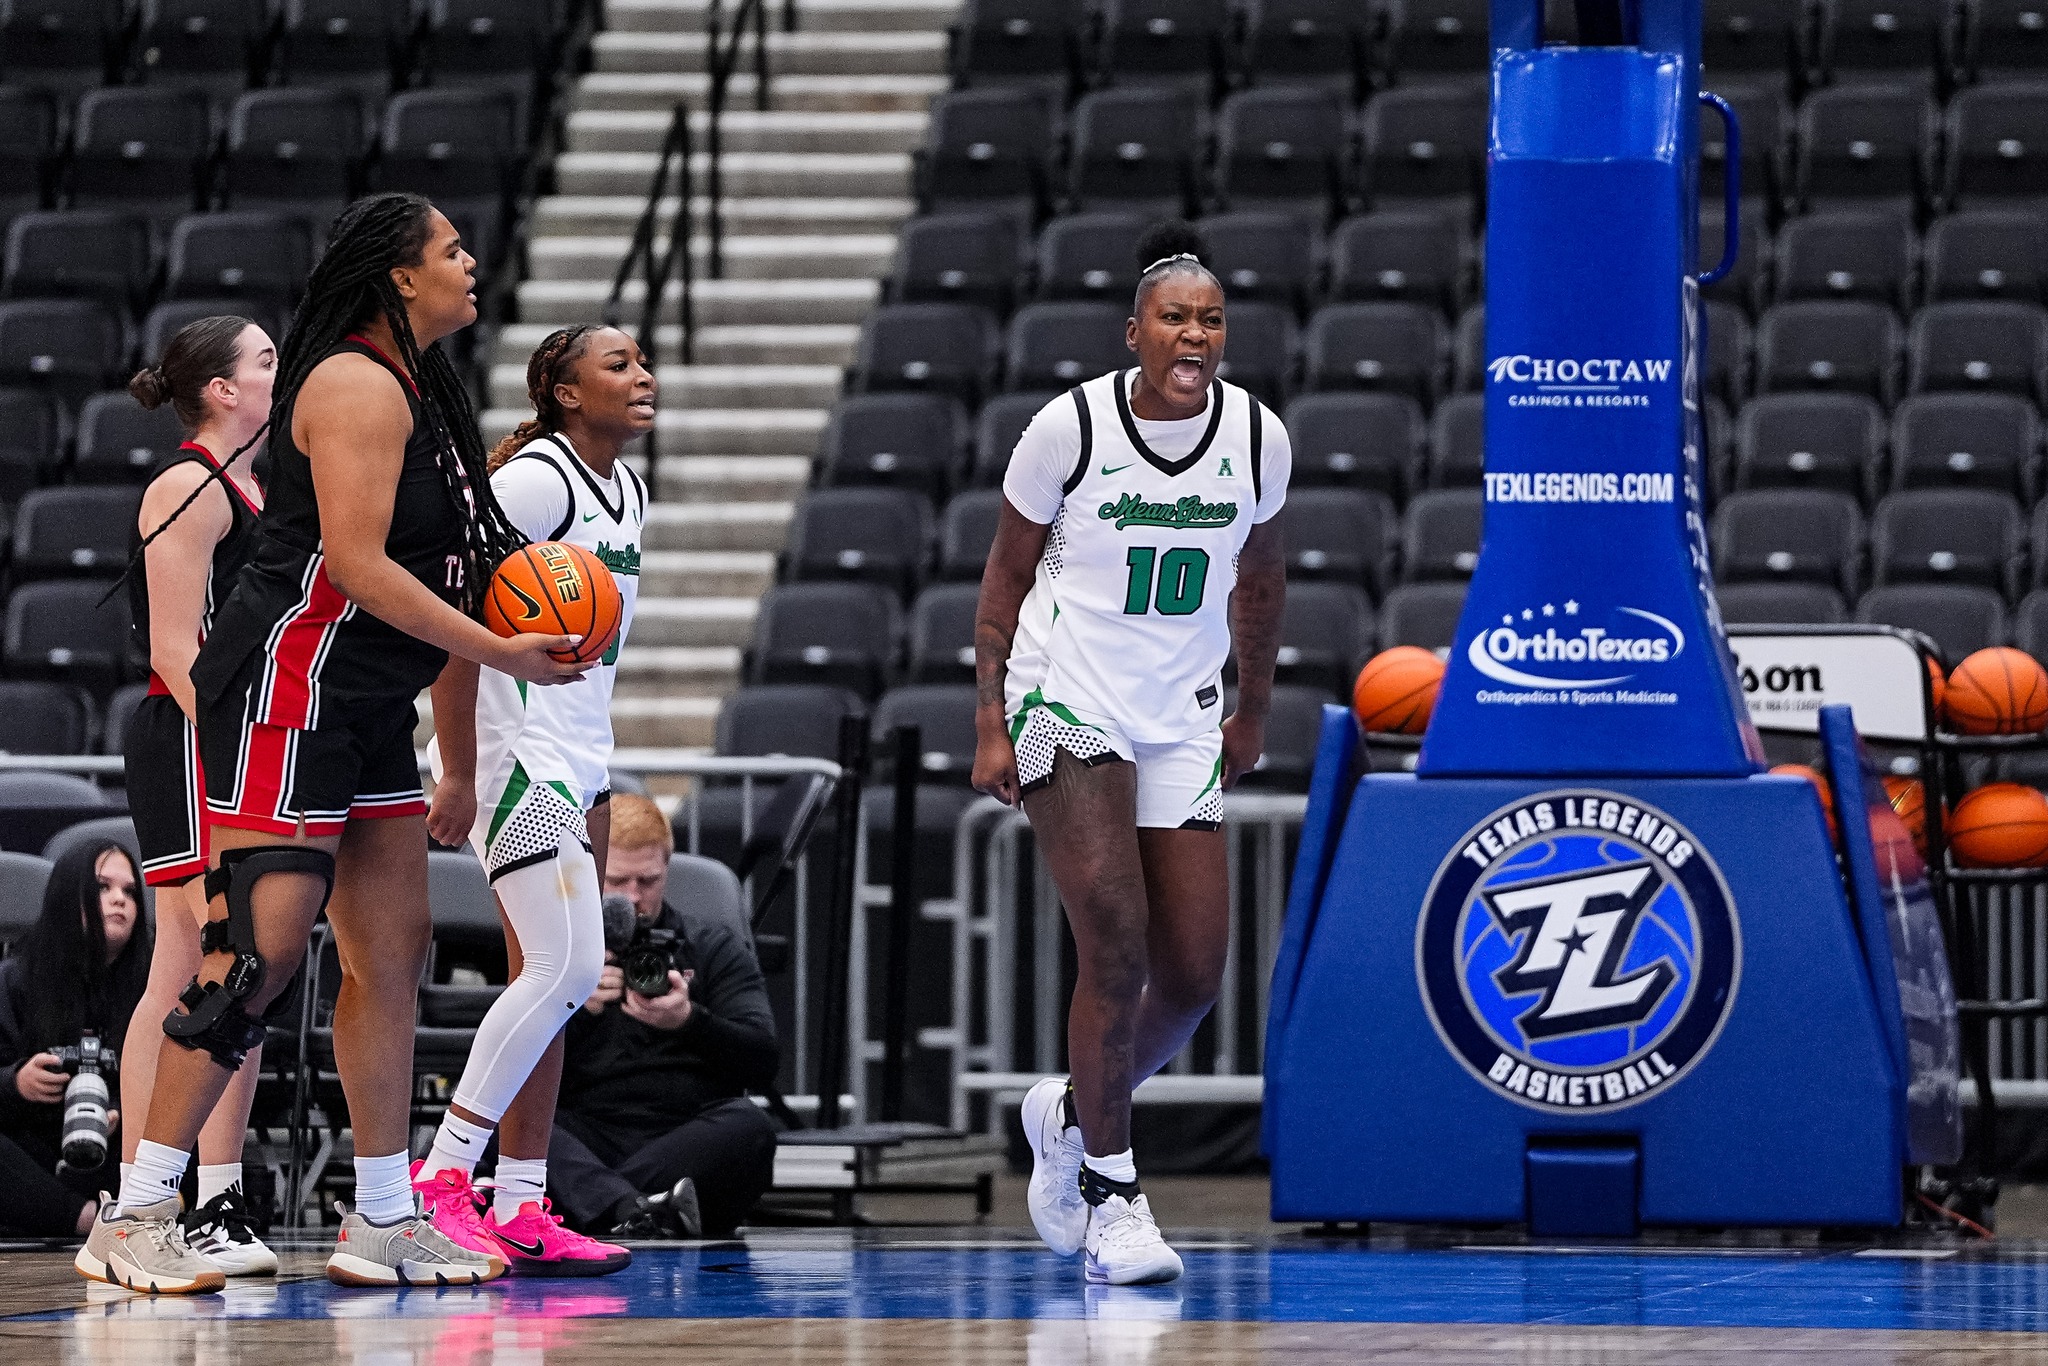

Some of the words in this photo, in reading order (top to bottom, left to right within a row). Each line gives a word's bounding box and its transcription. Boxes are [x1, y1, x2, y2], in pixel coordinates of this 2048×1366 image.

[1506, 355, 1672, 382] CHOCTAW
[1508, 395, 1571, 407] CASINOS
[1573, 396, 1584, 407] &
[1586, 396, 1650, 407] RESORTS
[1484, 472, 1675, 502] TEXLEGENDS.COM
[445, 554, 465, 589] TE
[536, 543, 581, 605] ELITE
[1123, 546, 1210, 615] 10
[1488, 628, 1669, 662] OrthoTexas
[1476, 690, 1557, 706] Orthopedics
[1559, 690, 1569, 704] &
[1572, 690, 1613, 706] Sports
[1616, 690, 1678, 704] Medicine
[1463, 802, 1556, 868] TEXAS
[1565, 798, 1695, 868] LEGENDS
[1488, 1051, 1676, 1105] BASKETBALL
